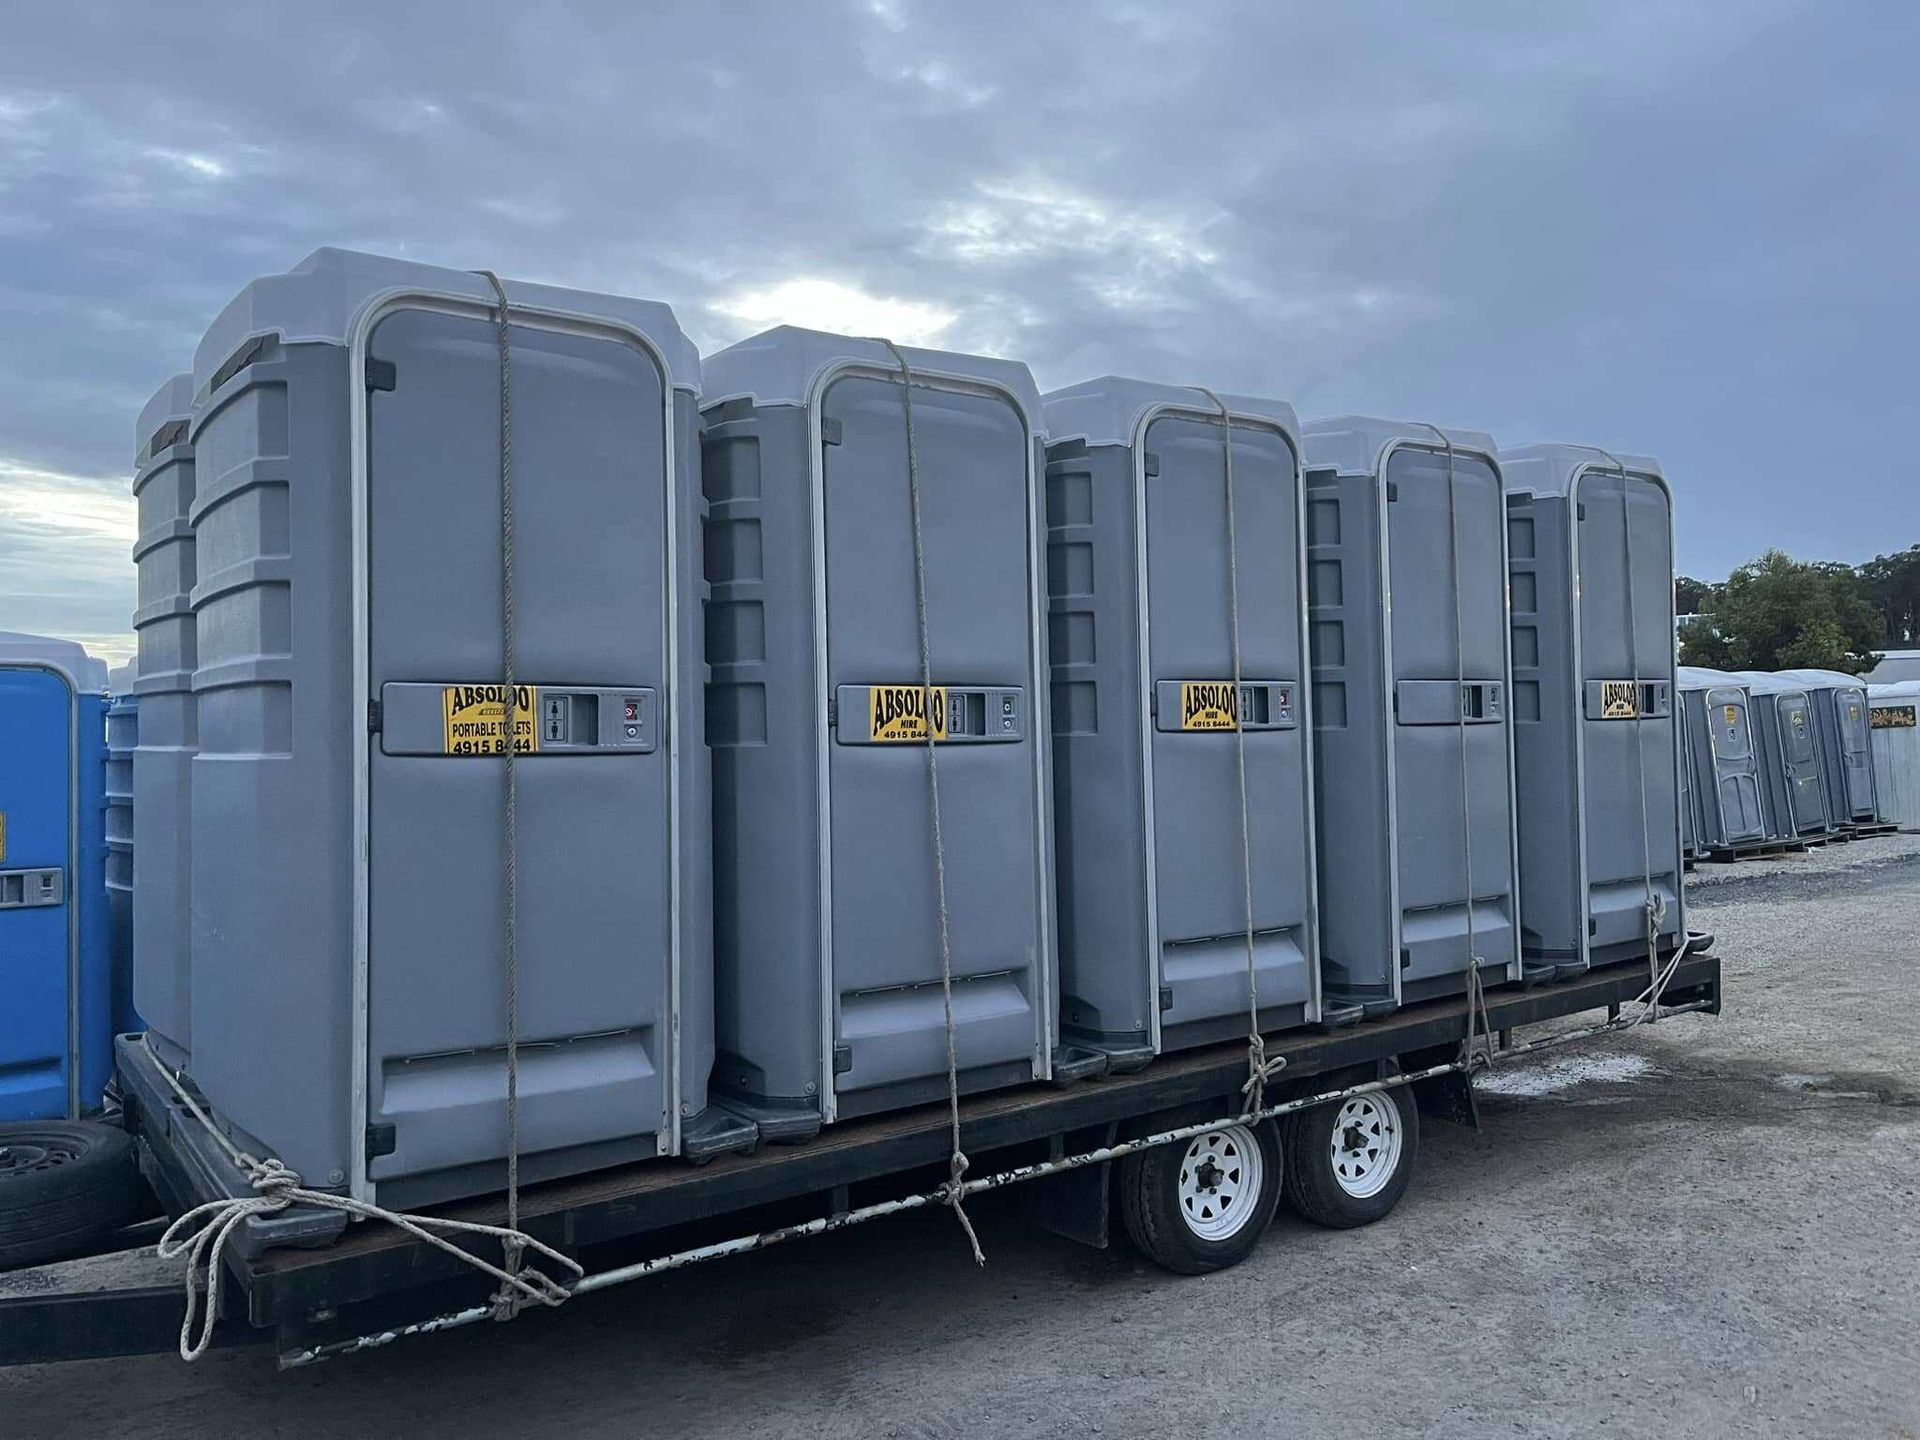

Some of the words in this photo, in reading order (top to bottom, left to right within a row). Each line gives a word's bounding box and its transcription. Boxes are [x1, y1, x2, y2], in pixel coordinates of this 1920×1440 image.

[1185, 685, 1237, 726] ABSOLOO
[453, 722, 496, 738] PORTABLE
[498, 720, 531, 736] TOETS
[901, 720, 917, 729] HIRE
[453, 740, 490, 753] 4915
[495, 738, 530, 753] 844
